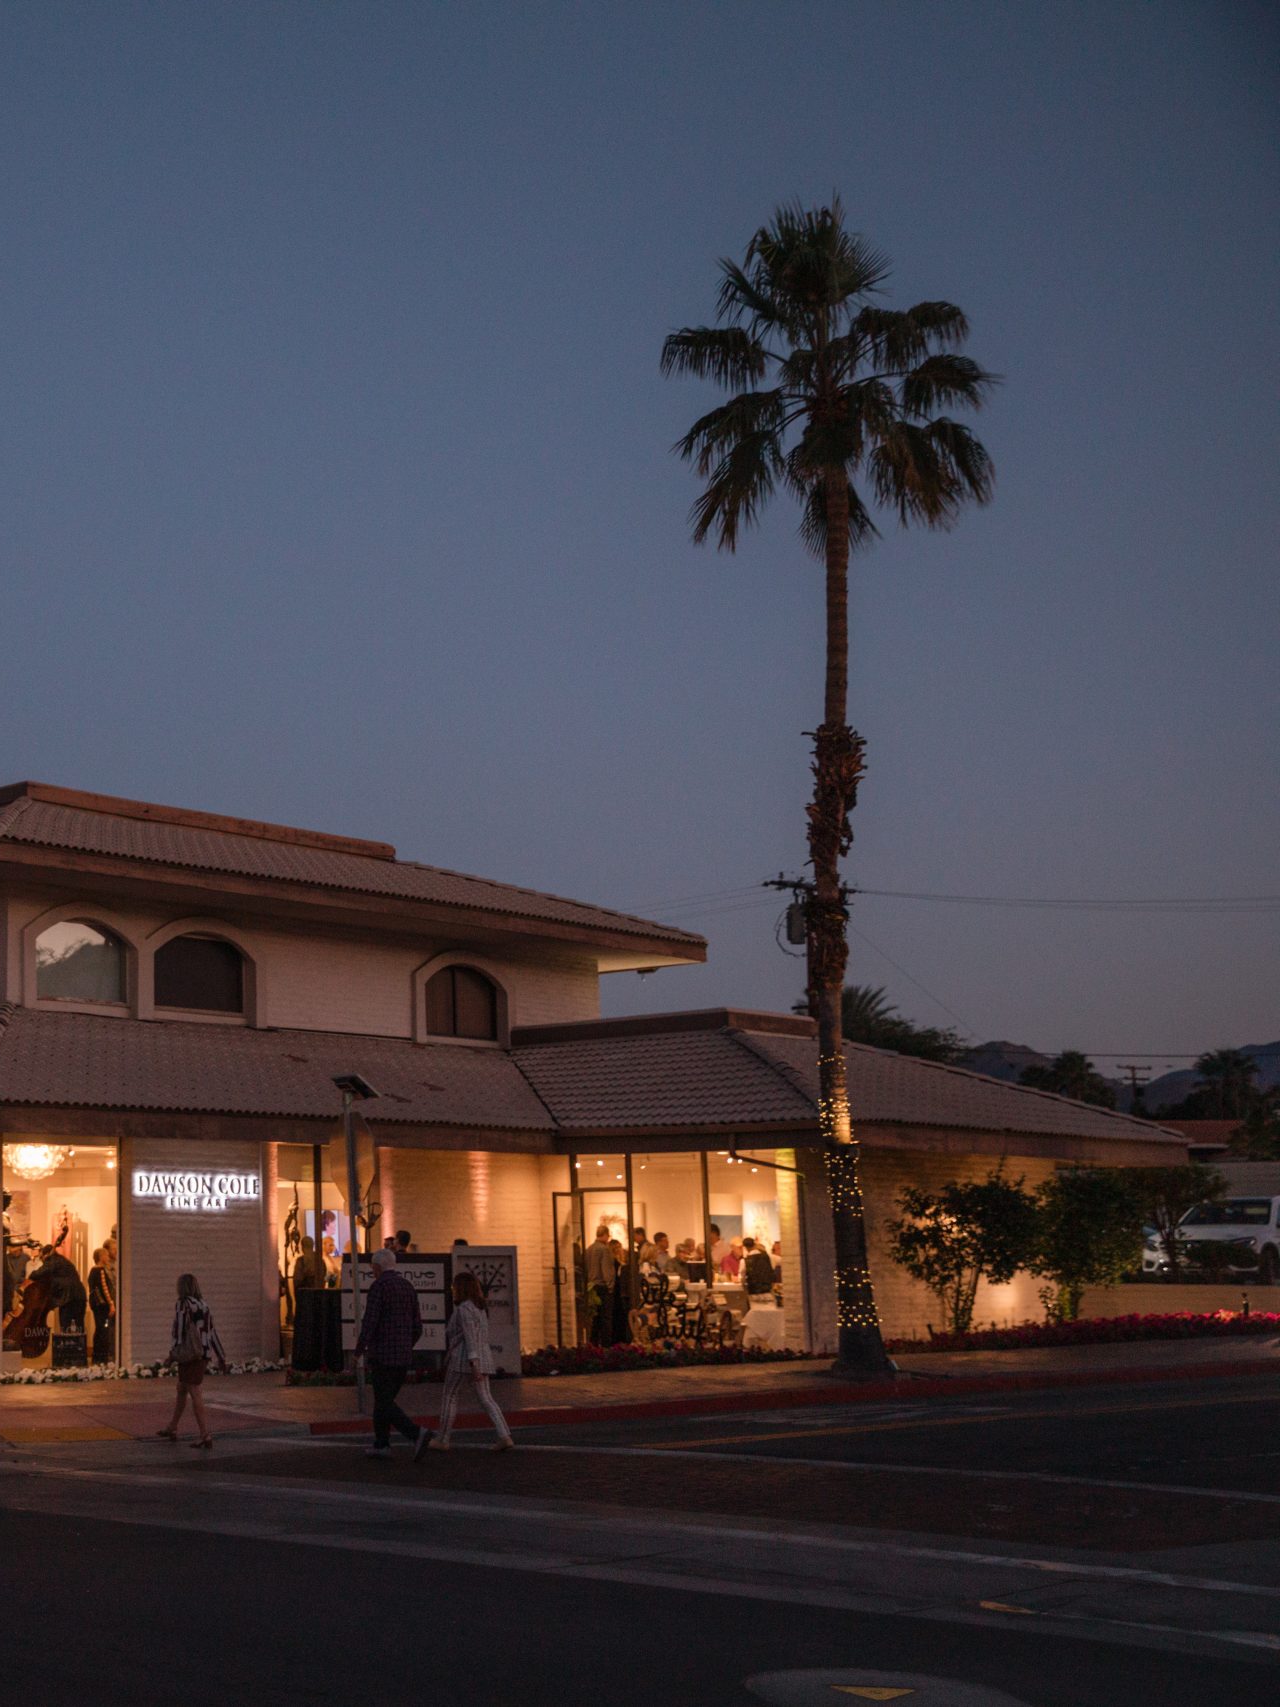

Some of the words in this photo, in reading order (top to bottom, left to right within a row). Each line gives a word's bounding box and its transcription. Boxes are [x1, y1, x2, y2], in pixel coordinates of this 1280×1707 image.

[138, 1175, 212, 1194] DAWSON
[218, 1176, 260, 1195] COLE
[170, 1197, 199, 1206] FINE
[206, 1198, 230, 1207] ART
